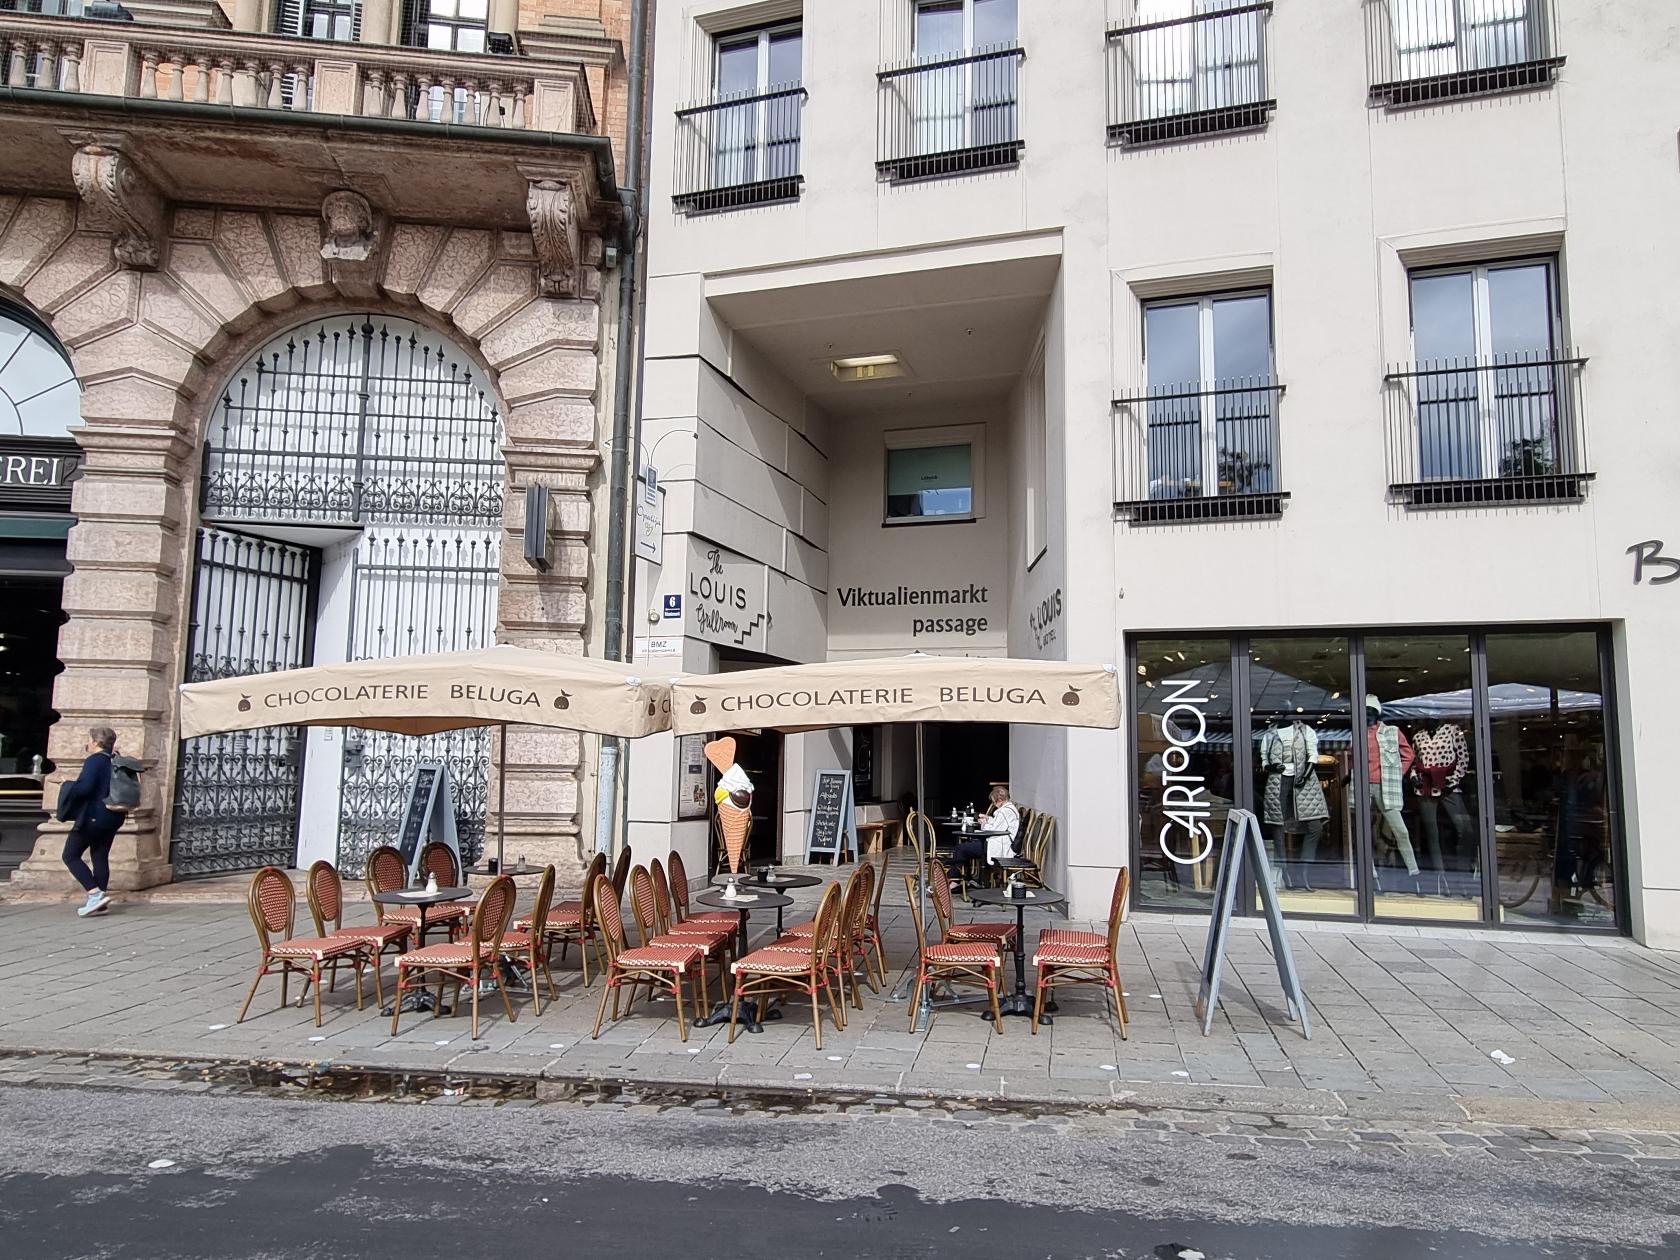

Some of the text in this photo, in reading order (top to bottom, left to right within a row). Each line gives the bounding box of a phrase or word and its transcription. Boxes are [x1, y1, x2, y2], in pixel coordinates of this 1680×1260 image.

[0, 456, 60, 486] REI
[707, 548, 724, 574] The
[669, 596, 676, 608] 6
[690, 571, 747, 610] LOUIS
[836, 583, 989, 607] Viktualienmarkt
[1036, 588, 1062, 630] LOUIS
[912, 616, 989, 637] passage
[650, 640, 667, 648] BMZ
[263, 683, 541, 709] CHOCOLATERIE BELUGA
[720, 686, 1047, 712] CHOCOLATERIE BELUGA
[1160, 679, 1213, 865] CARTOON
